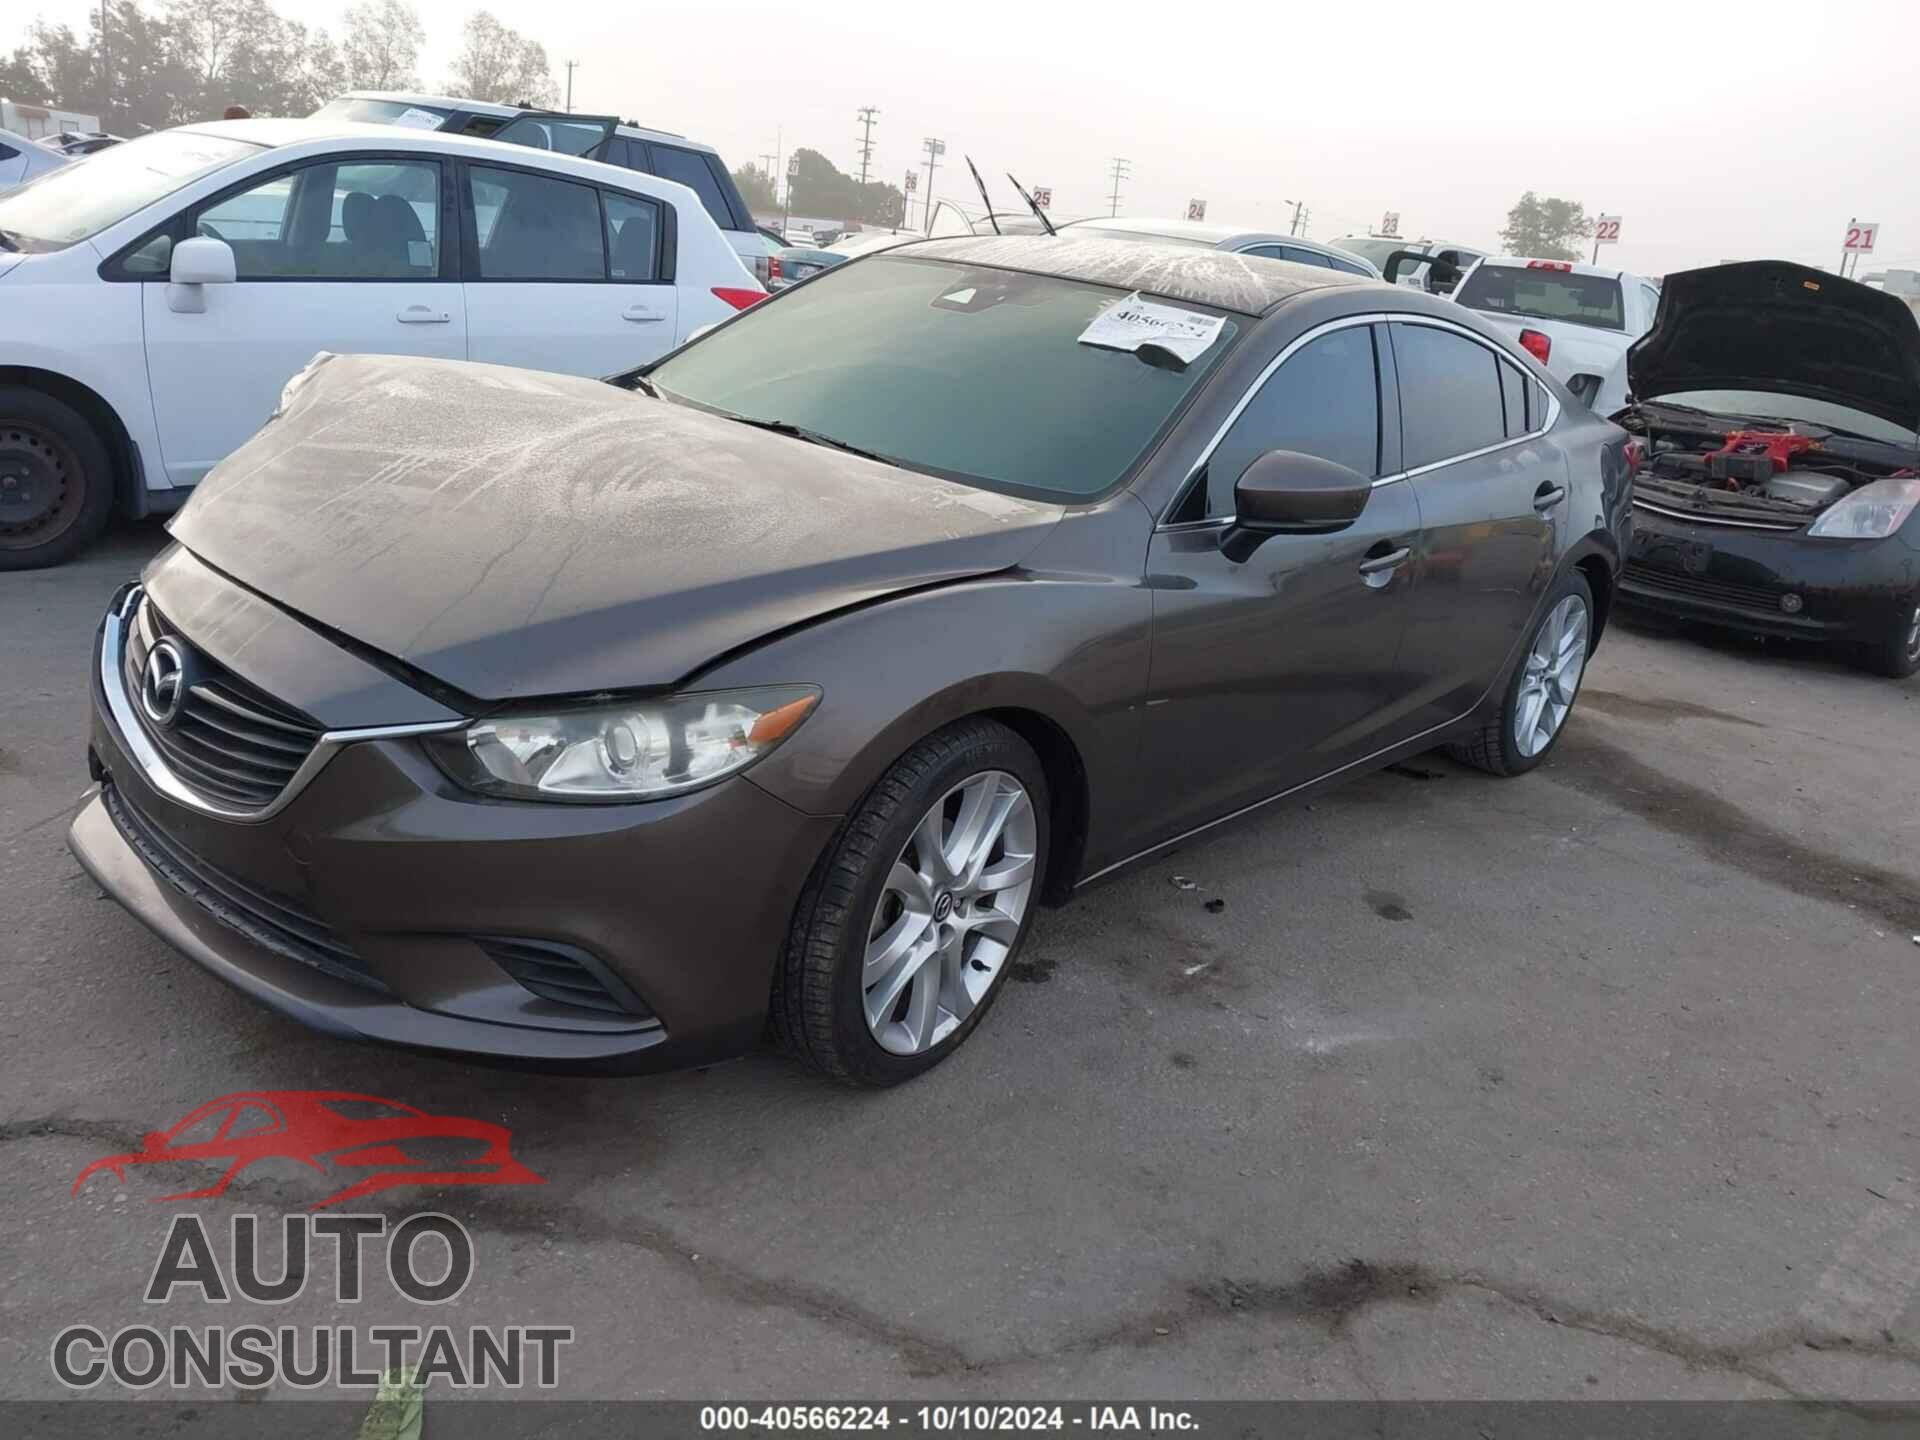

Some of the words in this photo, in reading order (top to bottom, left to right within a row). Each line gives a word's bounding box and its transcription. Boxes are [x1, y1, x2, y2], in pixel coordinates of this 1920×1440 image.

[905, 175, 917, 190] 26
[1034, 191, 1051, 206] 25
[1189, 204, 1205, 219] 24
[1382, 218, 1398, 233] 23
[1596, 221, 1620, 239] 22
[1845, 228, 1873, 248] 21
